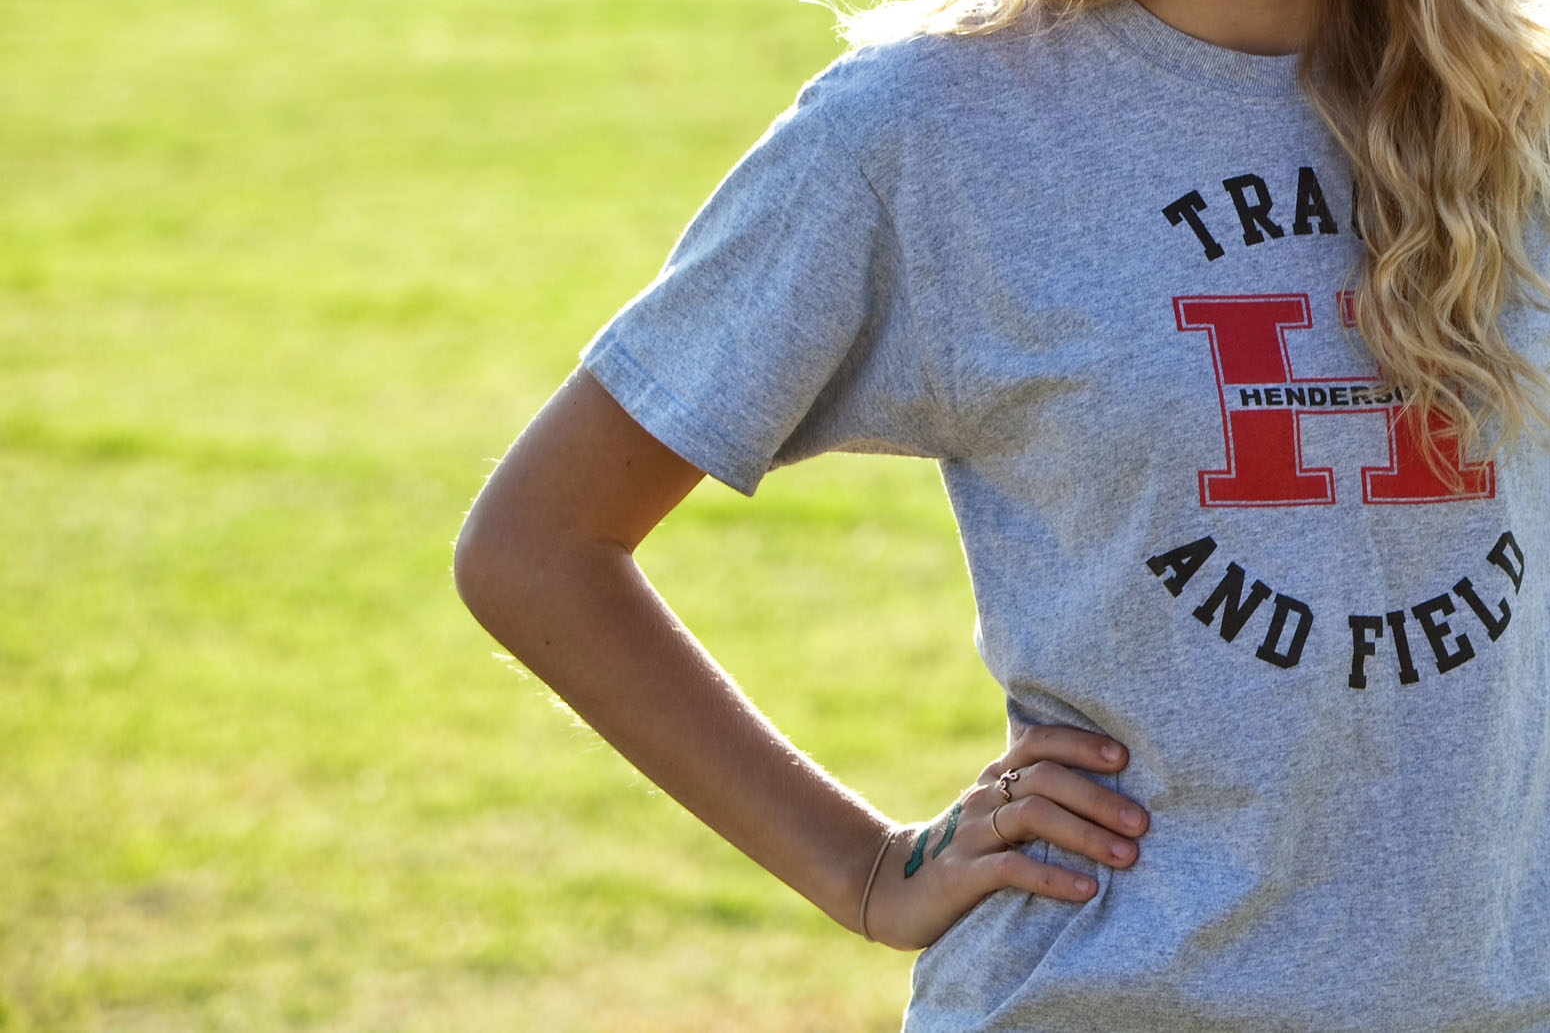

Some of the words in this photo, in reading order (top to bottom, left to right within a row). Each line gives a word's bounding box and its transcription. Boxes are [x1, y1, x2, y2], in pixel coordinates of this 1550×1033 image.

[1162, 166, 1364, 261] TRA
[1172, 291, 1495, 507] H
[1146, 536, 1314, 669] AND
[1348, 530, 1525, 689] FIELD
